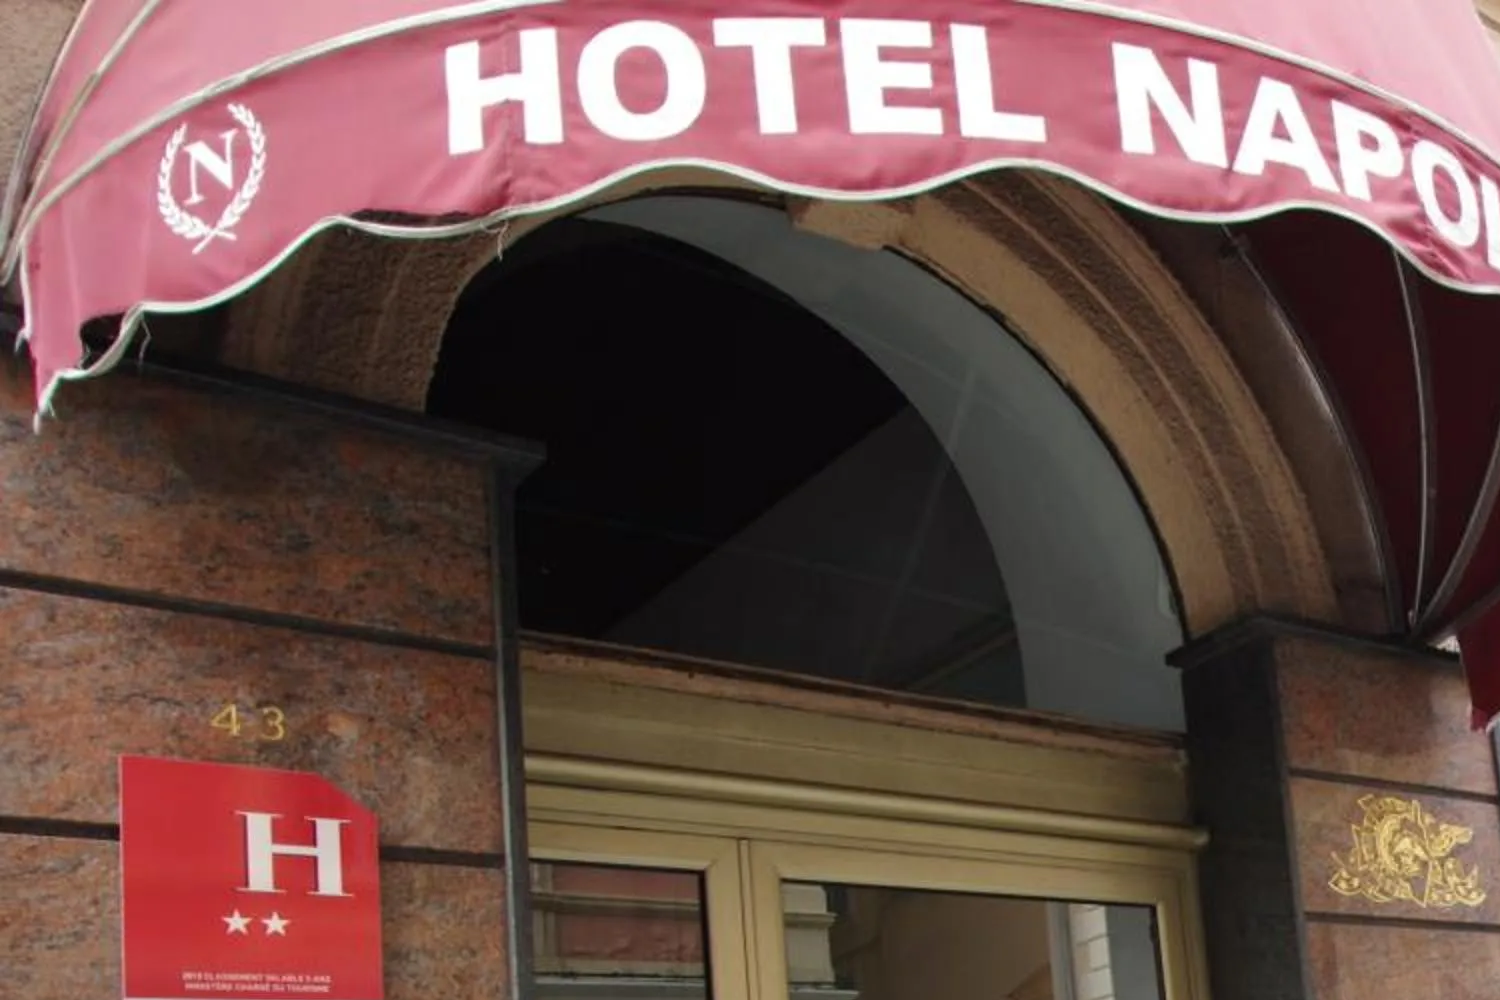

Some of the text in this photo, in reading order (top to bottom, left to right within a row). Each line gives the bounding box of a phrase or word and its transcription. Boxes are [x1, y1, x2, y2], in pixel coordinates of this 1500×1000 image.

[445, 16, 1046, 156] HOTEL
[184, 132, 235, 207] N
[210, 703, 286, 741] 43
[233, 810, 354, 898] H
